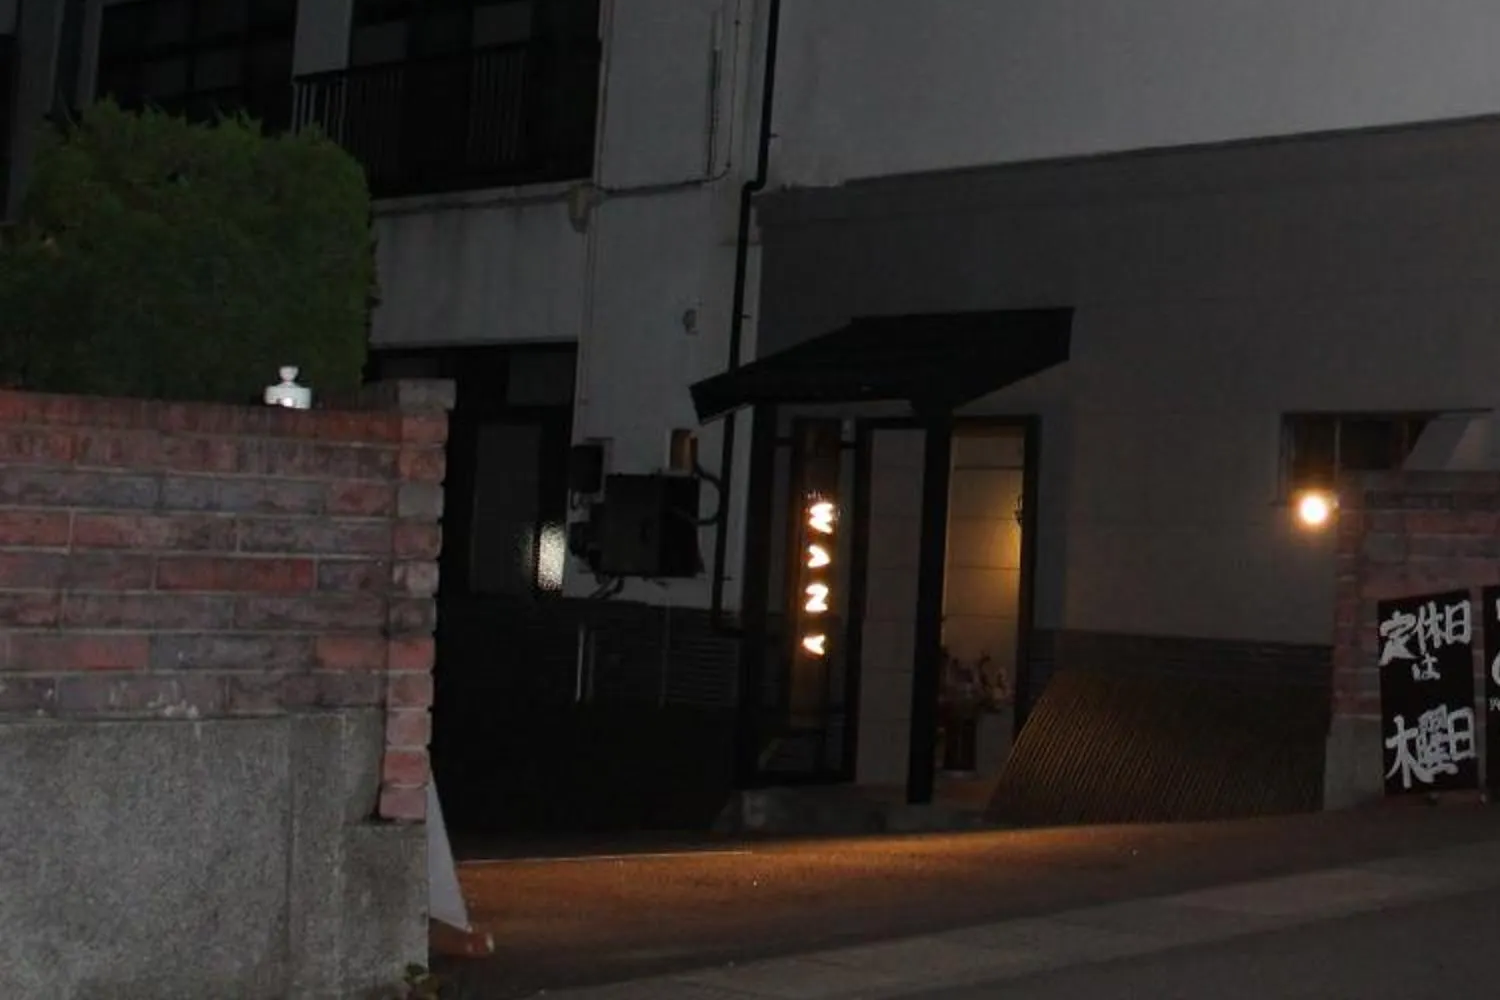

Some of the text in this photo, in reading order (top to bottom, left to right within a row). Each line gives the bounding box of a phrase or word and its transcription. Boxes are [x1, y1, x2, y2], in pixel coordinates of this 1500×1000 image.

[1379, 600, 1472, 666] 定休日
[1411, 653, 1441, 681] は
[1385, 703, 1476, 788] 木曜日
